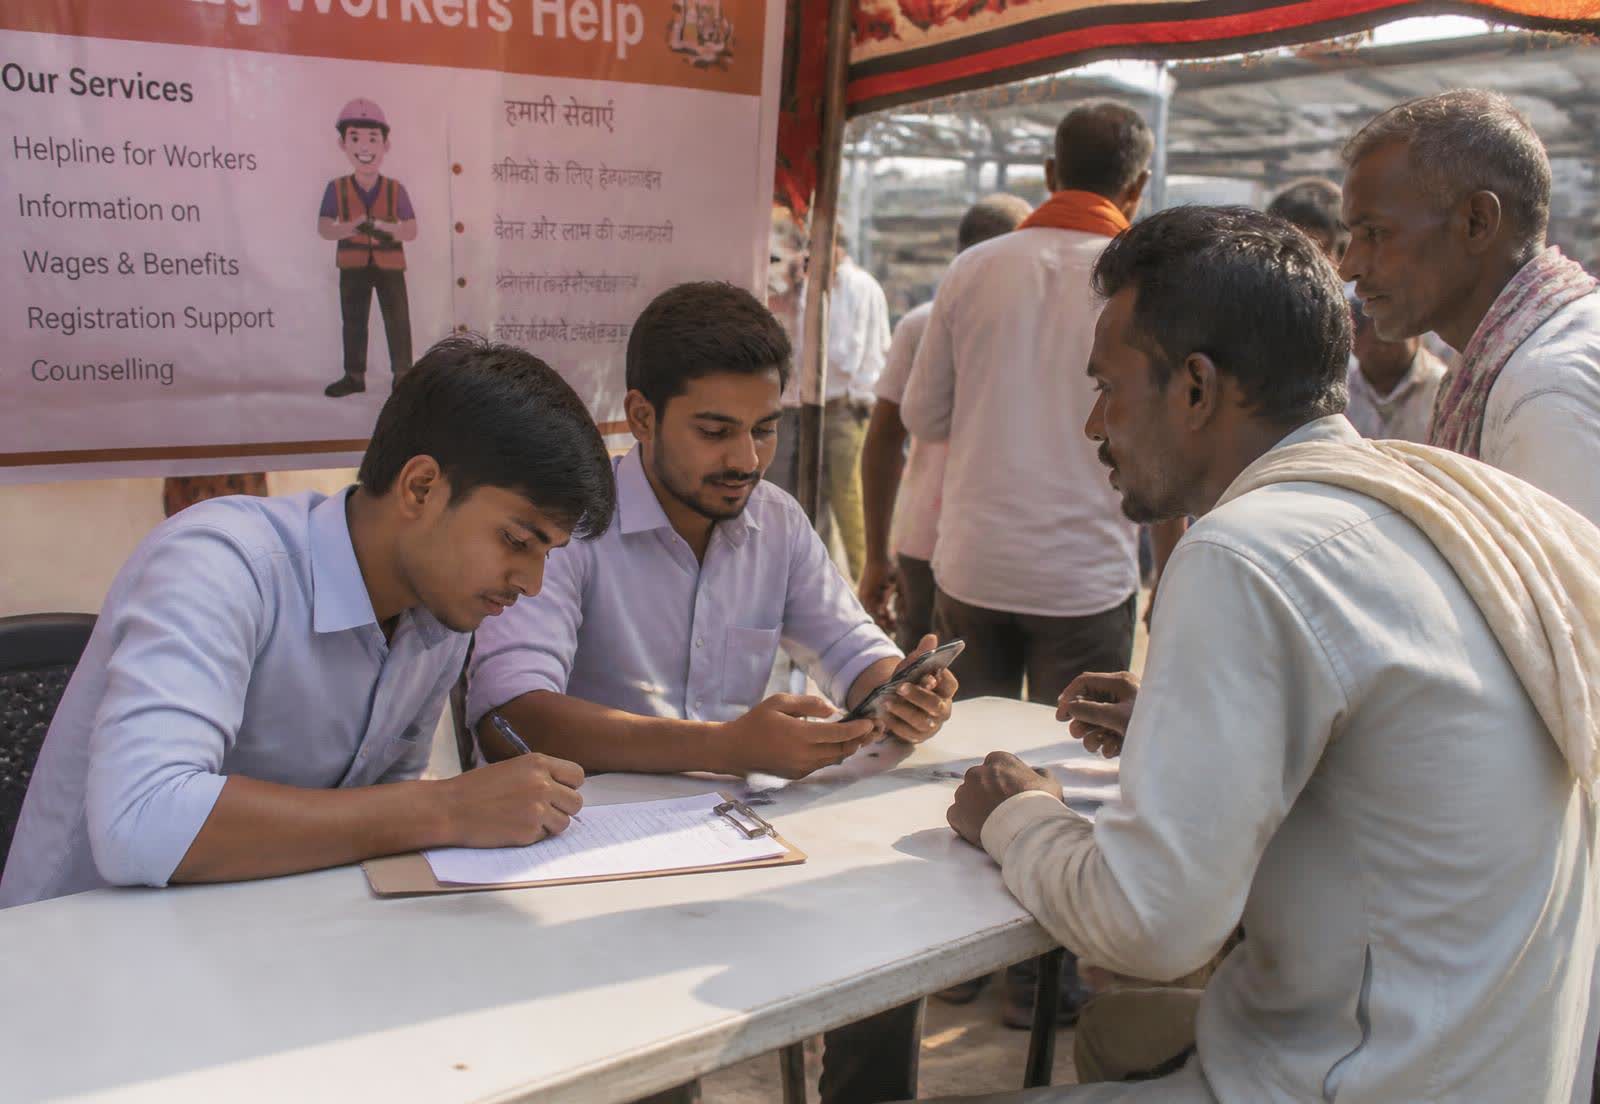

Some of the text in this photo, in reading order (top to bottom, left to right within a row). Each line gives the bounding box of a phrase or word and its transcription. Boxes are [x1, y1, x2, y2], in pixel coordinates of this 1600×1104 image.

[287, 0, 513, 32] rkers
[532, 0, 645, 59] Help
[1, 62, 194, 103] Our Services
[504, 95, 556, 127] हमारी
[13, 135, 257, 171] Helpline for Workers
[19, 193, 200, 222] Information on
[24, 250, 240, 281] Wages & Benefits
[28, 306, 276, 336] Registration Support
[31, 358, 175, 386] Counselling
